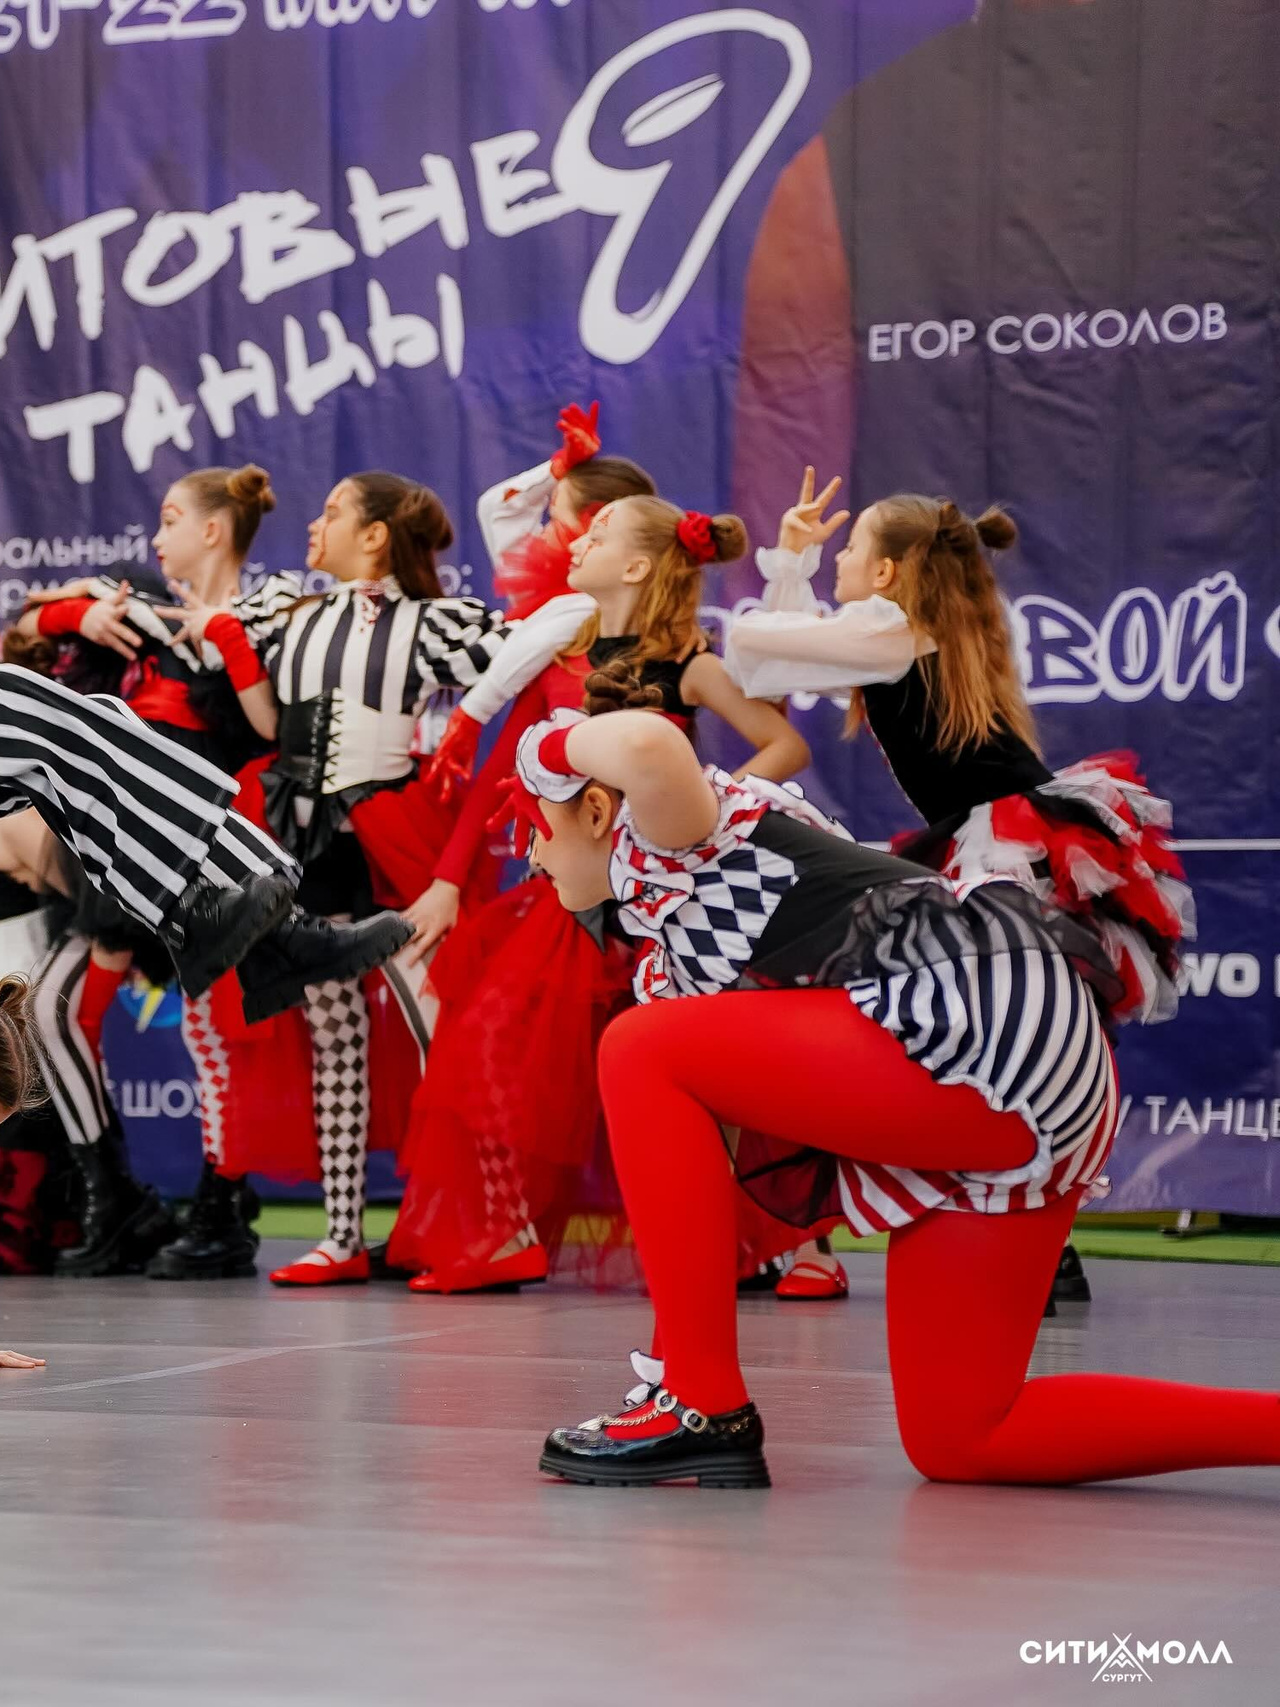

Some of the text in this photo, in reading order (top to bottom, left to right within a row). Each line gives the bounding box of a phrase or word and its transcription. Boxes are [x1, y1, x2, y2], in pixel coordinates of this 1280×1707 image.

[24, 273, 464, 483] ТАНЦЫ
[868, 301, 1228, 362] ЕГОР СОКОЛОВ
